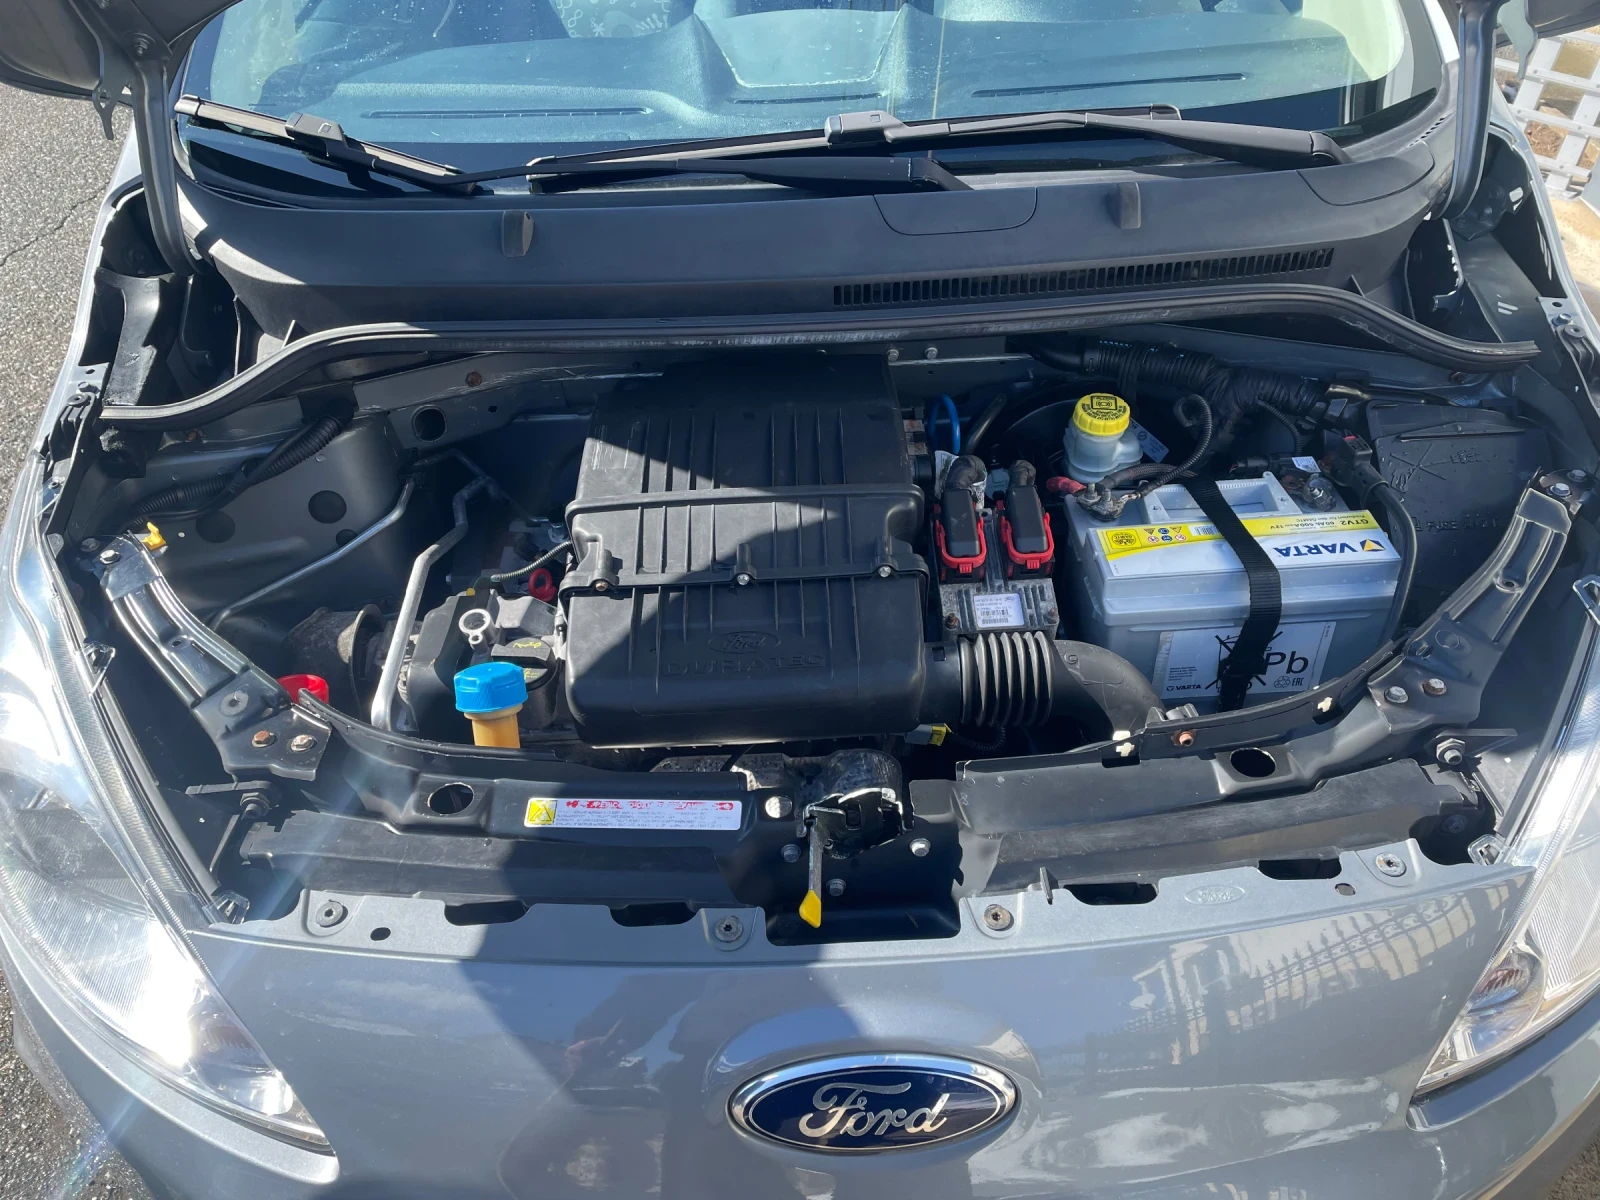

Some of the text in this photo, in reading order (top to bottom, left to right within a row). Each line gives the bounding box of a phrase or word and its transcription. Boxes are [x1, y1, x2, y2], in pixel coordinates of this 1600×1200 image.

[1340, 518, 1369, 526] GTV2
[1273, 542, 1358, 557] VARTA
[1265, 651, 1309, 675] Pb
[798, 1081, 950, 1138] Ford
